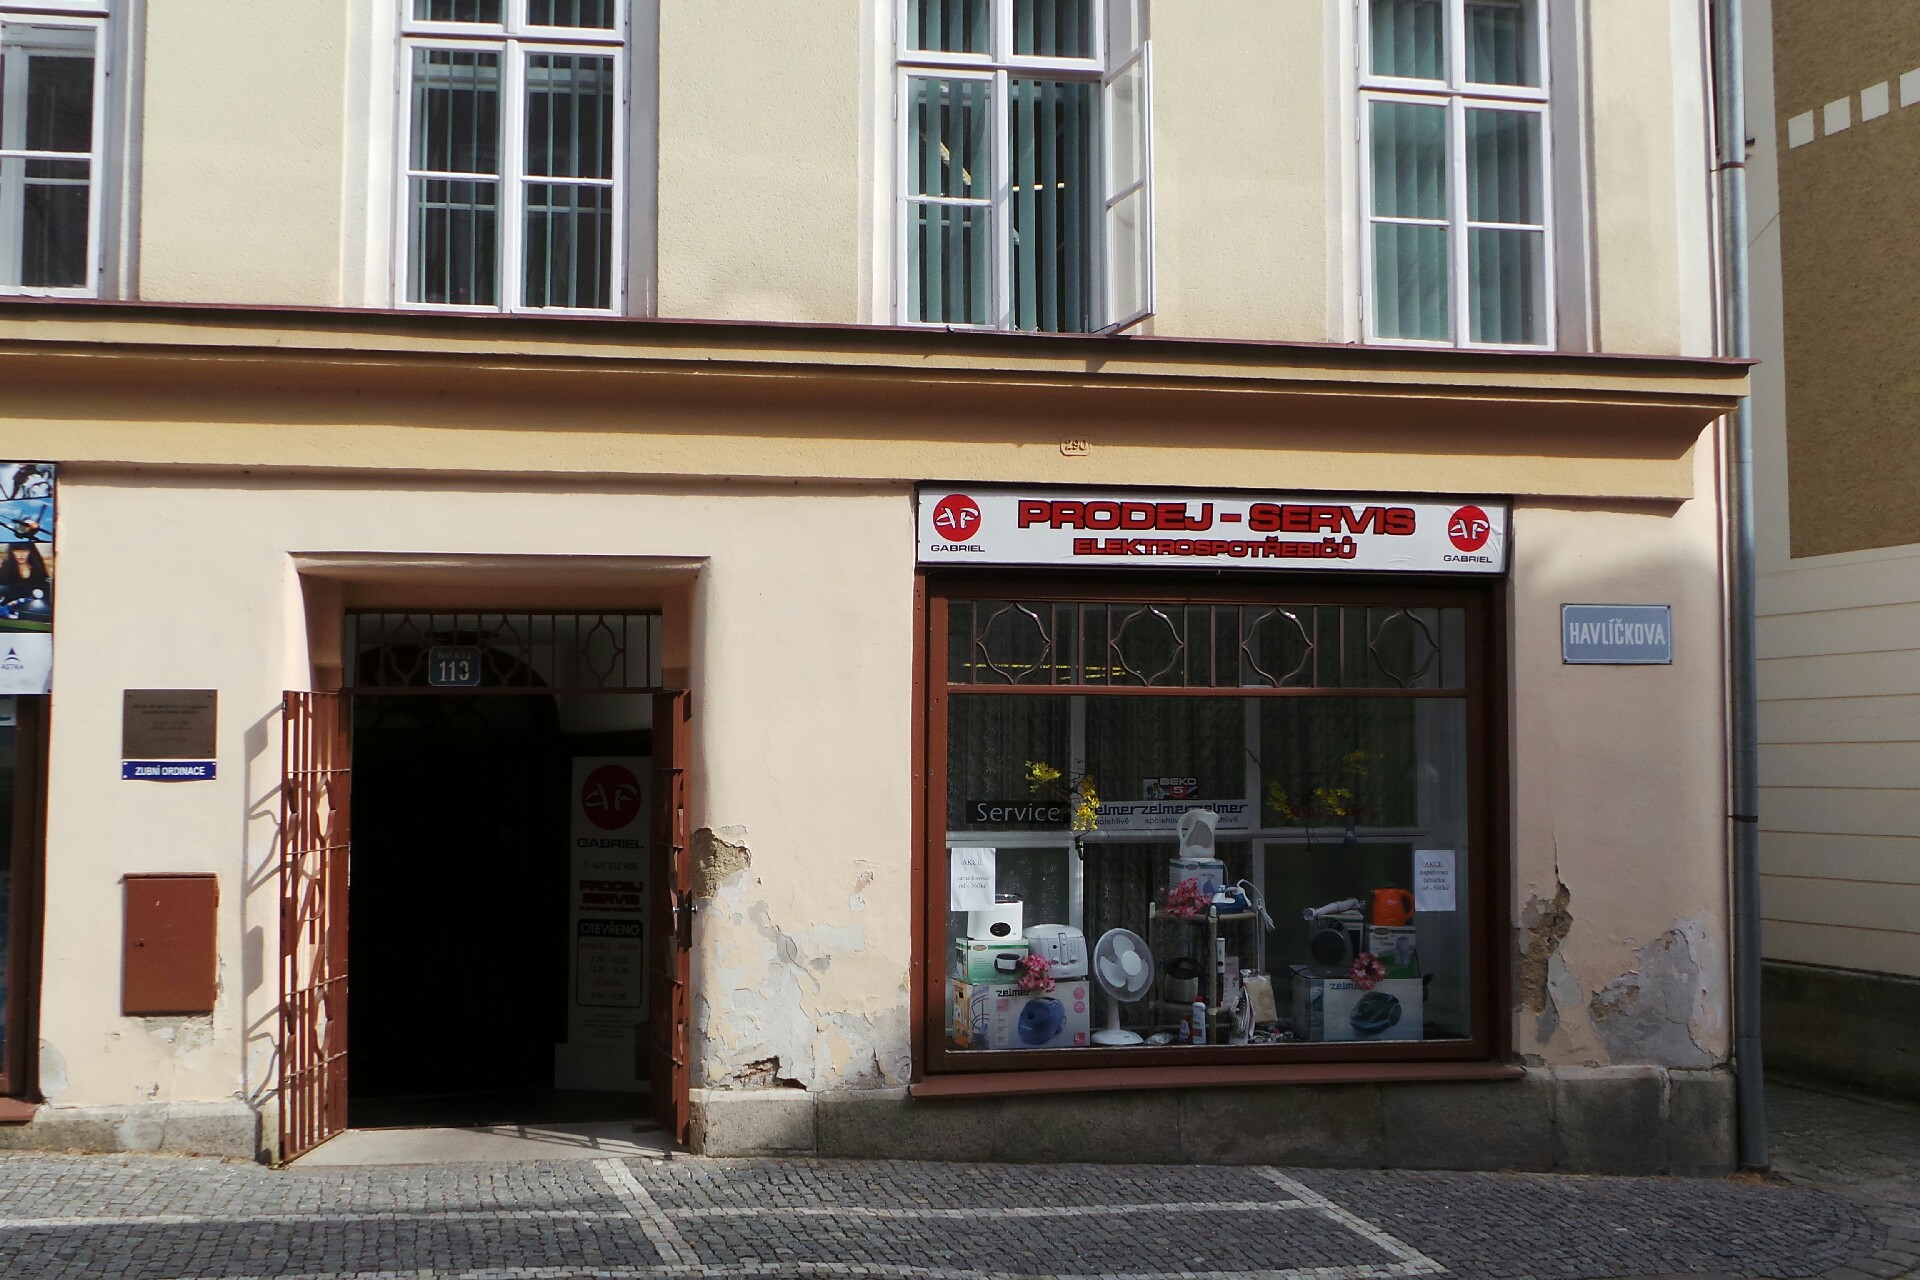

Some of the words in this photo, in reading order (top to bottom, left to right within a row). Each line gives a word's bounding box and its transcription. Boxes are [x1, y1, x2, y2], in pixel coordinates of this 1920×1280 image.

[1017, 499, 1214, 531] PRODEJ
[1248, 503, 1416, 536] SERVIS
[930, 544, 986, 552] GABRIEL
[1073, 535, 1358, 560] ELEKTROSPOTŘEBIČŮ
[1443, 555, 1494, 564] GABRIEL
[1569, 618, 1666, 645] HAVLÍČKOVA
[439, 660, 470, 682] 113
[134, 764, 161, 776] ZUBNÍ
[161, 766, 206, 776] ORDINACE
[1160, 777, 1197, 786] BEKO
[1173, 786, 1184, 794] 5
[976, 803, 1061, 822] Service
[1095, 804, 1137, 815] elmer
[577, 838, 644, 849] GABRIEL
[580, 920, 641, 936] OTEVŘENO
